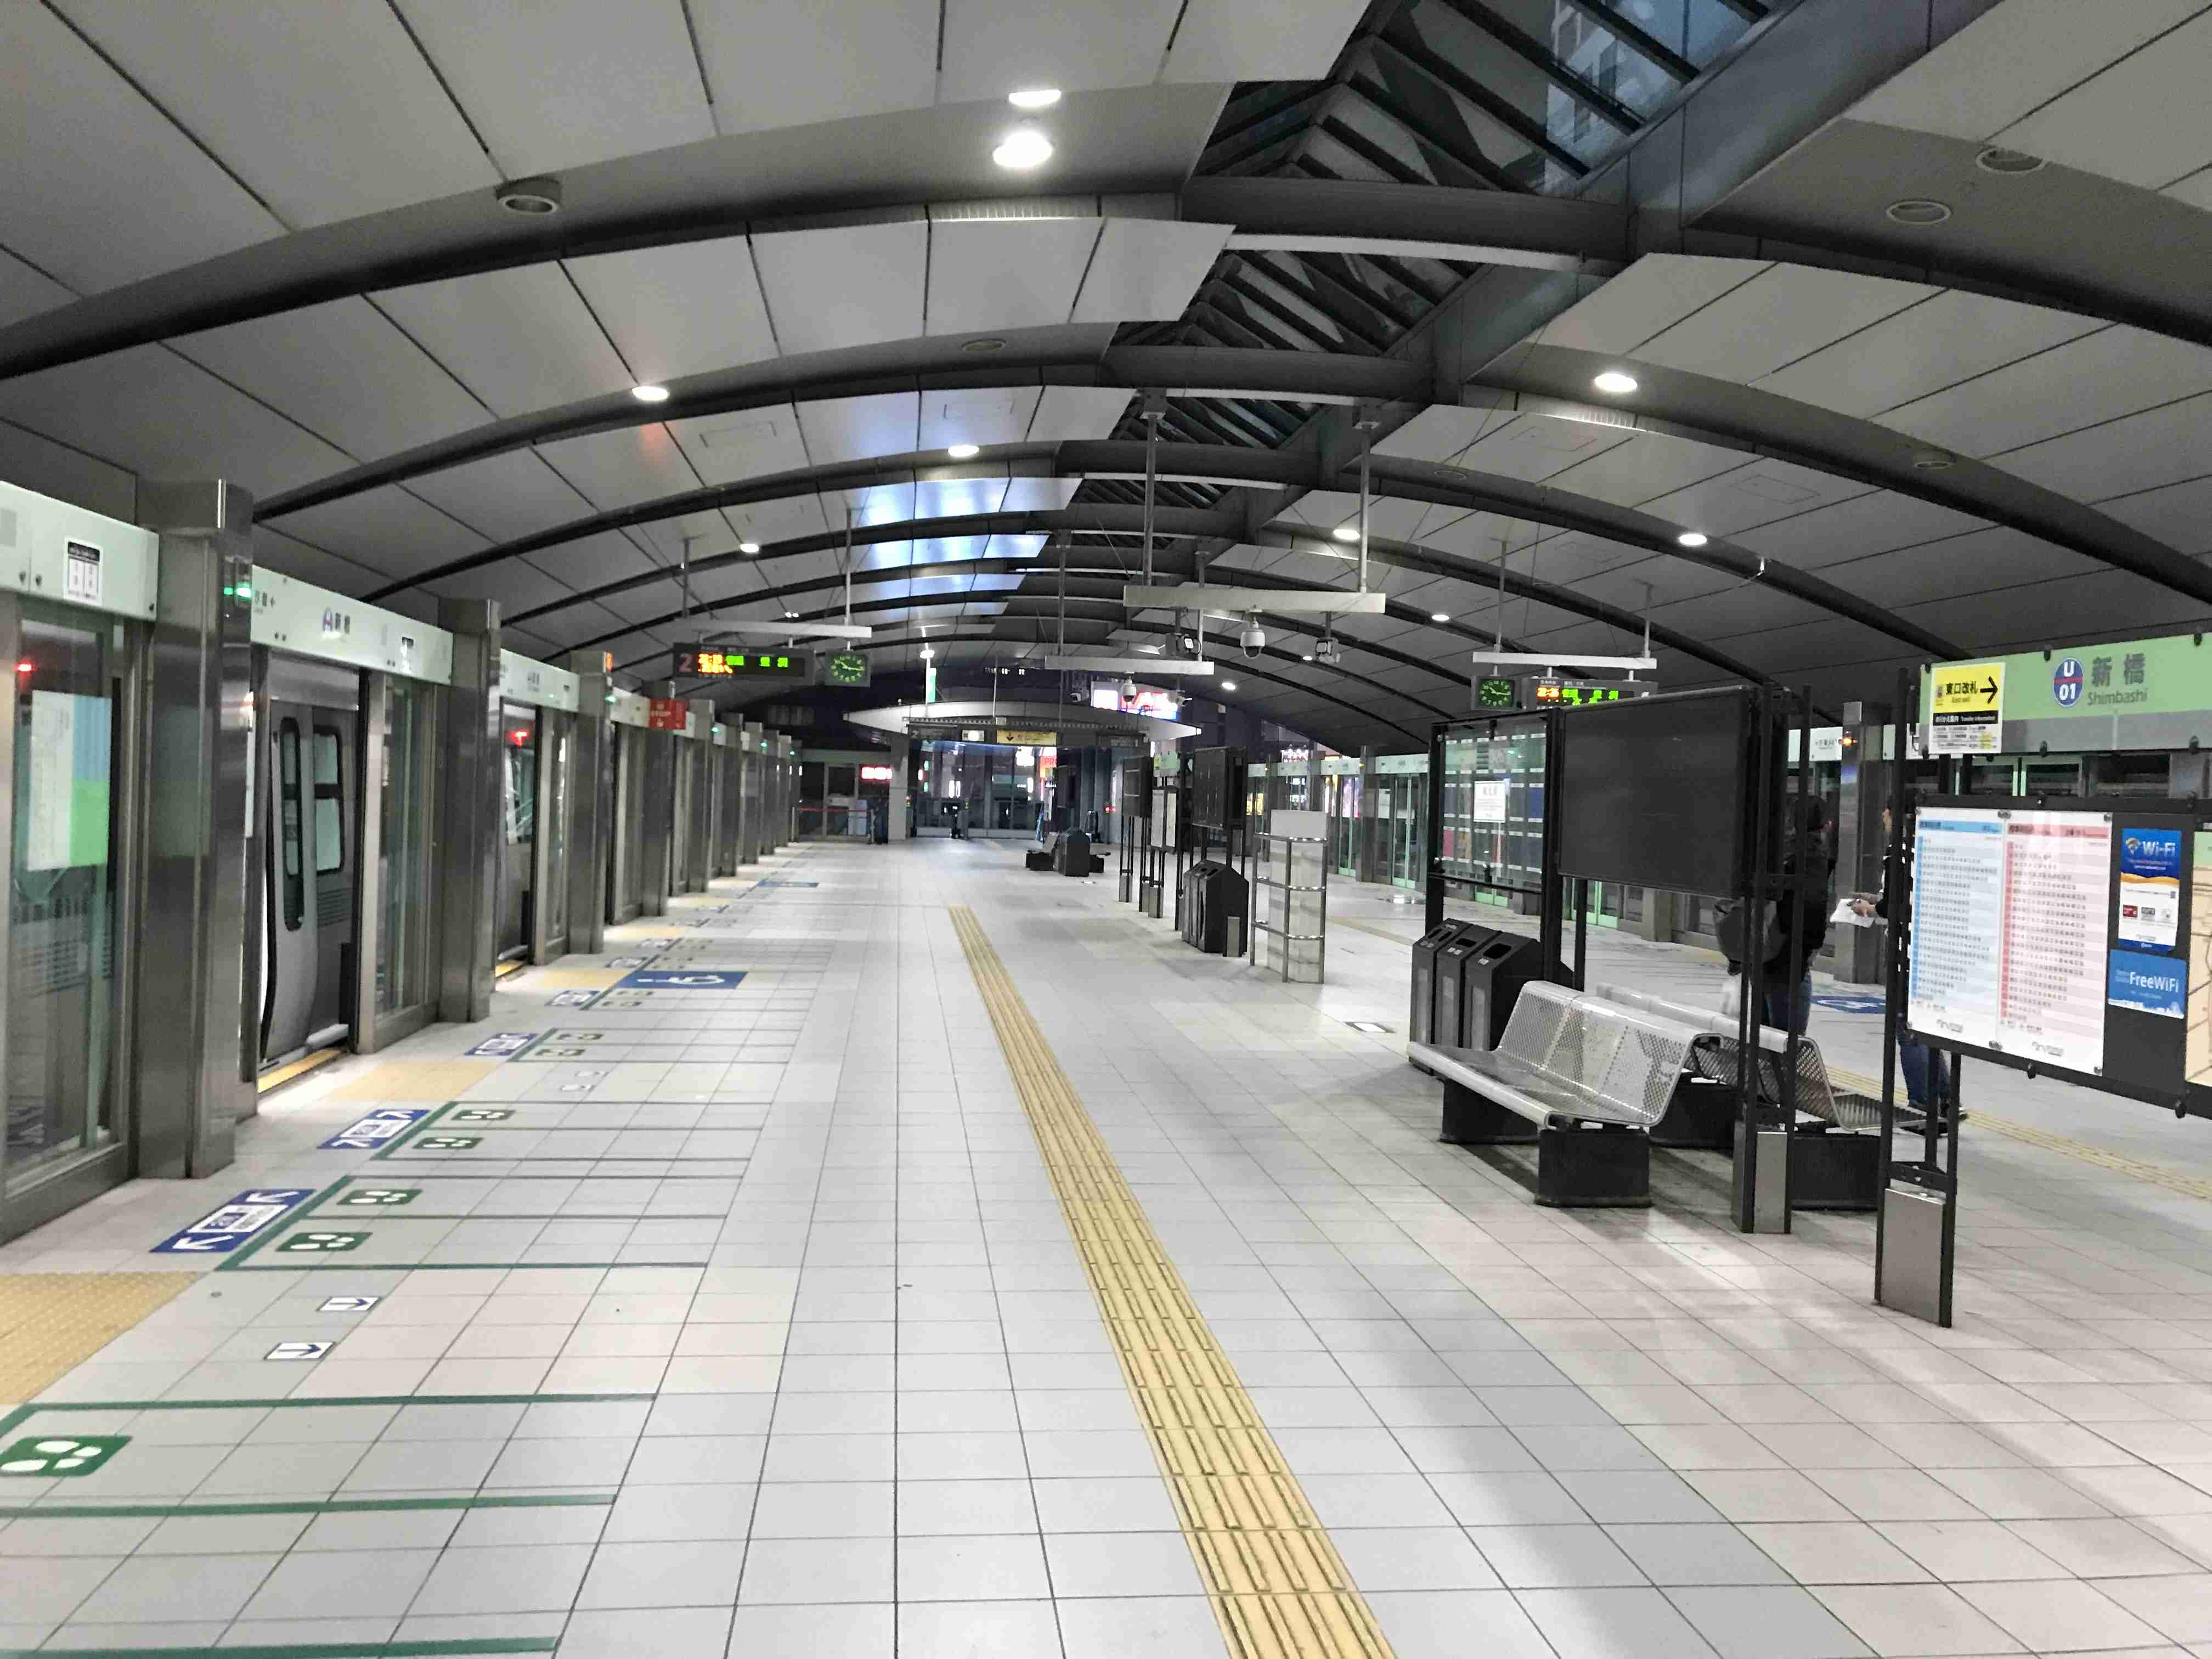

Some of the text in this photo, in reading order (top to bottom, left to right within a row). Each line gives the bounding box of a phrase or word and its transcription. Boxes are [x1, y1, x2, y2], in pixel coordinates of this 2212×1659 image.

[679, 653, 693, 673] 2
[2063, 661, 2075, 678] U
[2059, 682, 2076, 701] 01
[2087, 687, 2149, 706] Shimbashi
[2142, 840, 2176, 857] Wi-Fi
[2129, 971, 2179, 992] FreeWiFi
